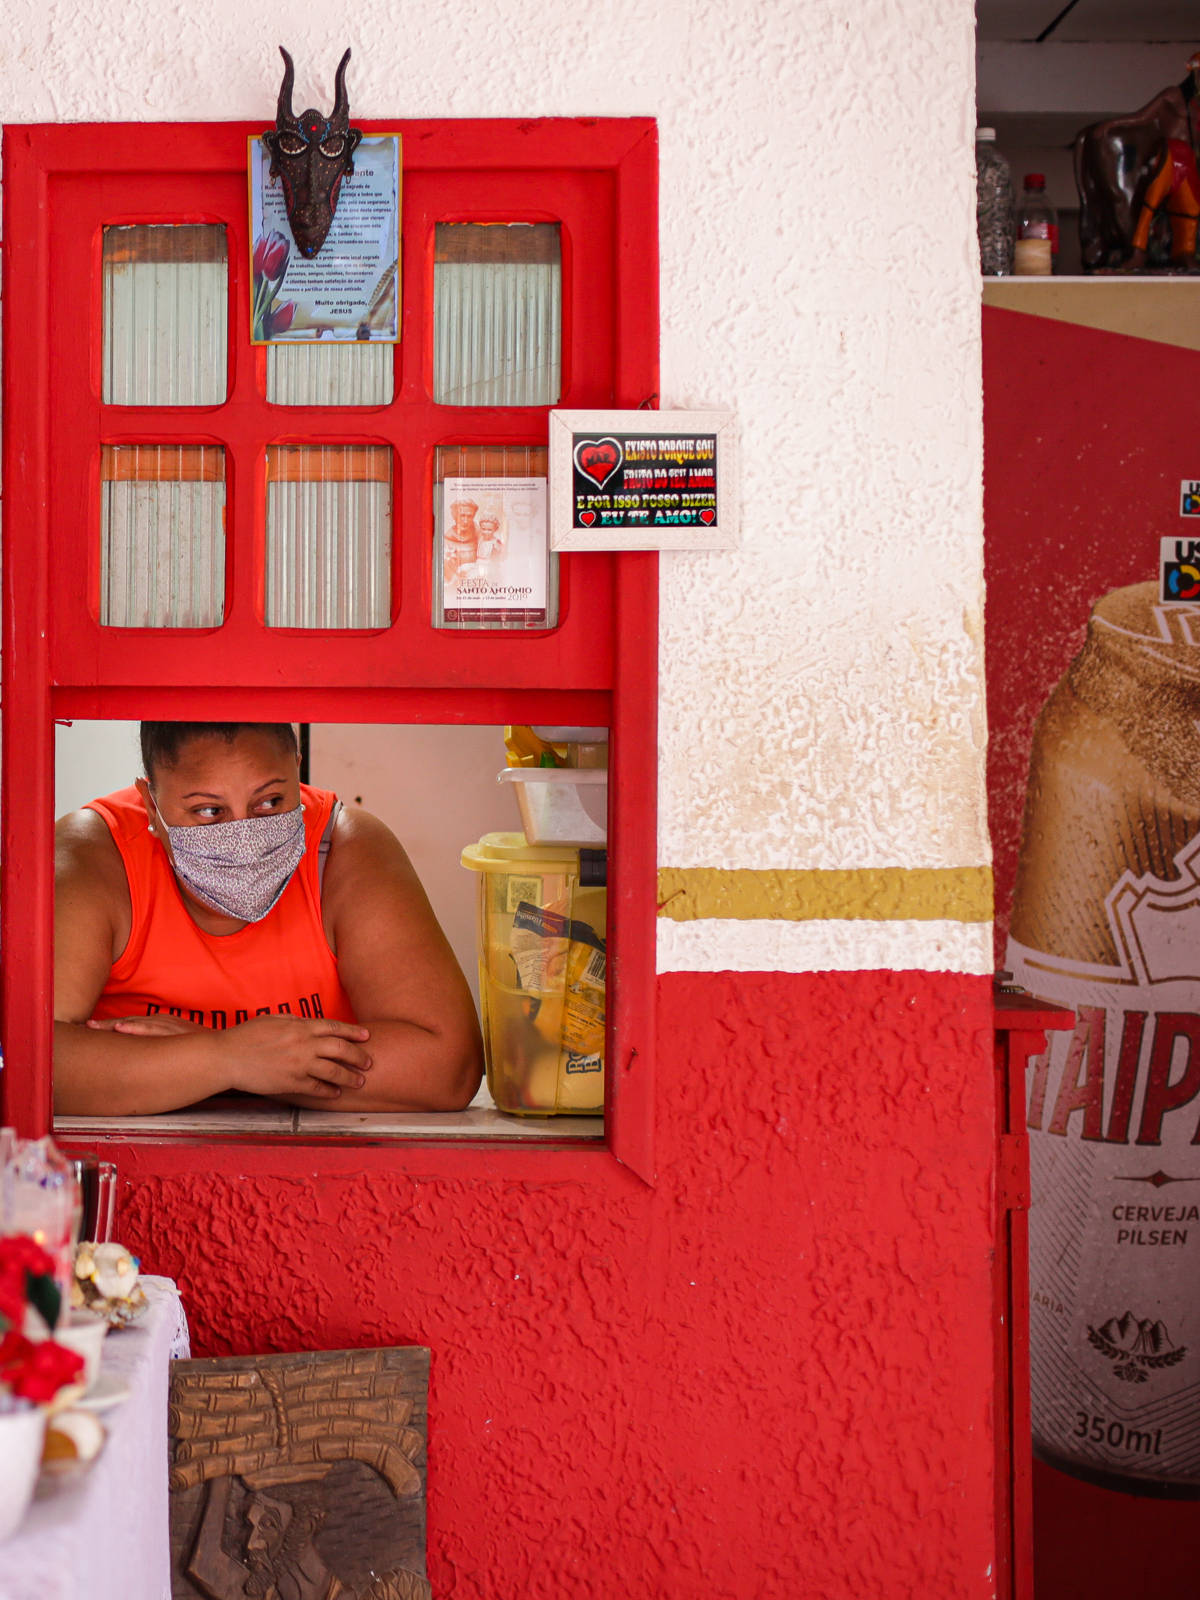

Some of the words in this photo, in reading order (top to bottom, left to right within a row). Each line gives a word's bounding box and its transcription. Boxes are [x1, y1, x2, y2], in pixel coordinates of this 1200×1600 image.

[335, 299, 368, 307] obrigado,
[624, 440, 657, 461] EXISTO
[658, 439, 695, 464] PORQUE
[696, 439, 714, 460] SOU
[654, 468, 668, 488] DO
[576, 495, 585, 509] E
[587, 495, 611, 509] POR
[613, 494, 640, 508] ISSO
[642, 494, 679, 509] POSSO
[681, 493, 716, 507] DIZER
[600, 510, 624, 525] EU
[628, 510, 649, 525] TE
[654, 509, 697, 524] AMO!
[457, 586, 488, 594] SANTO
[460, 578, 489, 587] FESTA
[1112, 1205, 1200, 1222] CERVEJA
[1117, 1229, 1188, 1247] PILSEN
[1072, 1411, 1163, 1456] 350ml
